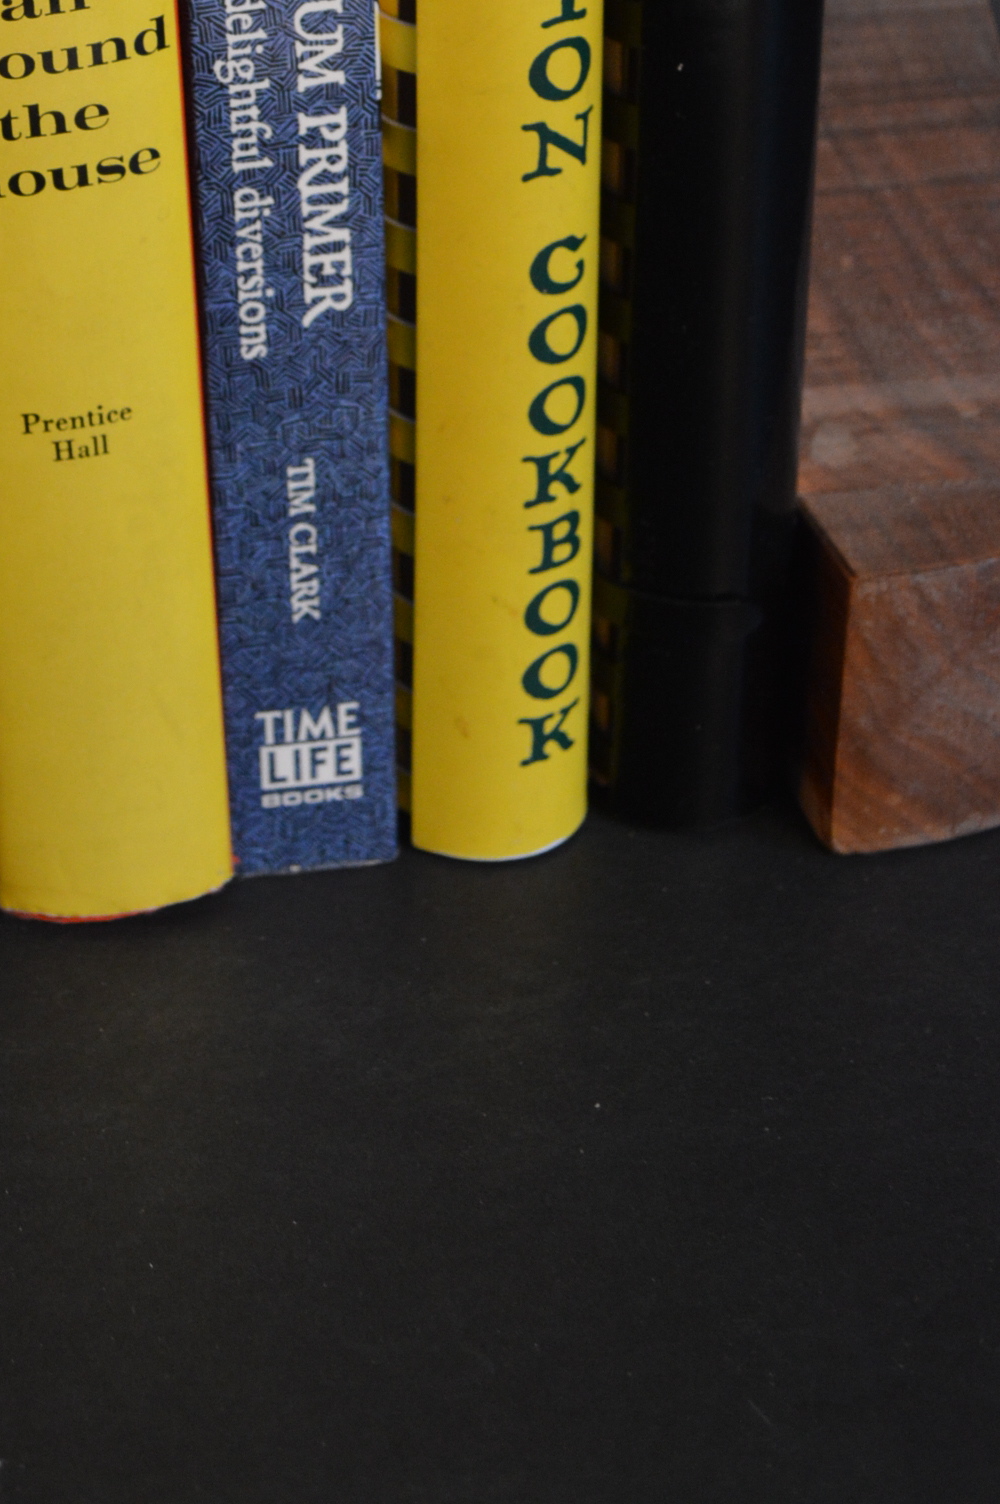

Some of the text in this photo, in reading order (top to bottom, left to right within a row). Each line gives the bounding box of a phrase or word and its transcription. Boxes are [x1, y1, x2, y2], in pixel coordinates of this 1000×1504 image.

[297, 106, 354, 329] PRIMER
[234, 186, 275, 362] diversions
[21, 404, 132, 435] Prentice
[52, 434, 110, 462] Hall
[286, 457, 322, 626] TIM CLARK
[518, 234, 588, 767] COOKBOOK
[254, 701, 363, 745] TIME
[267, 743, 355, 784] LIFE
